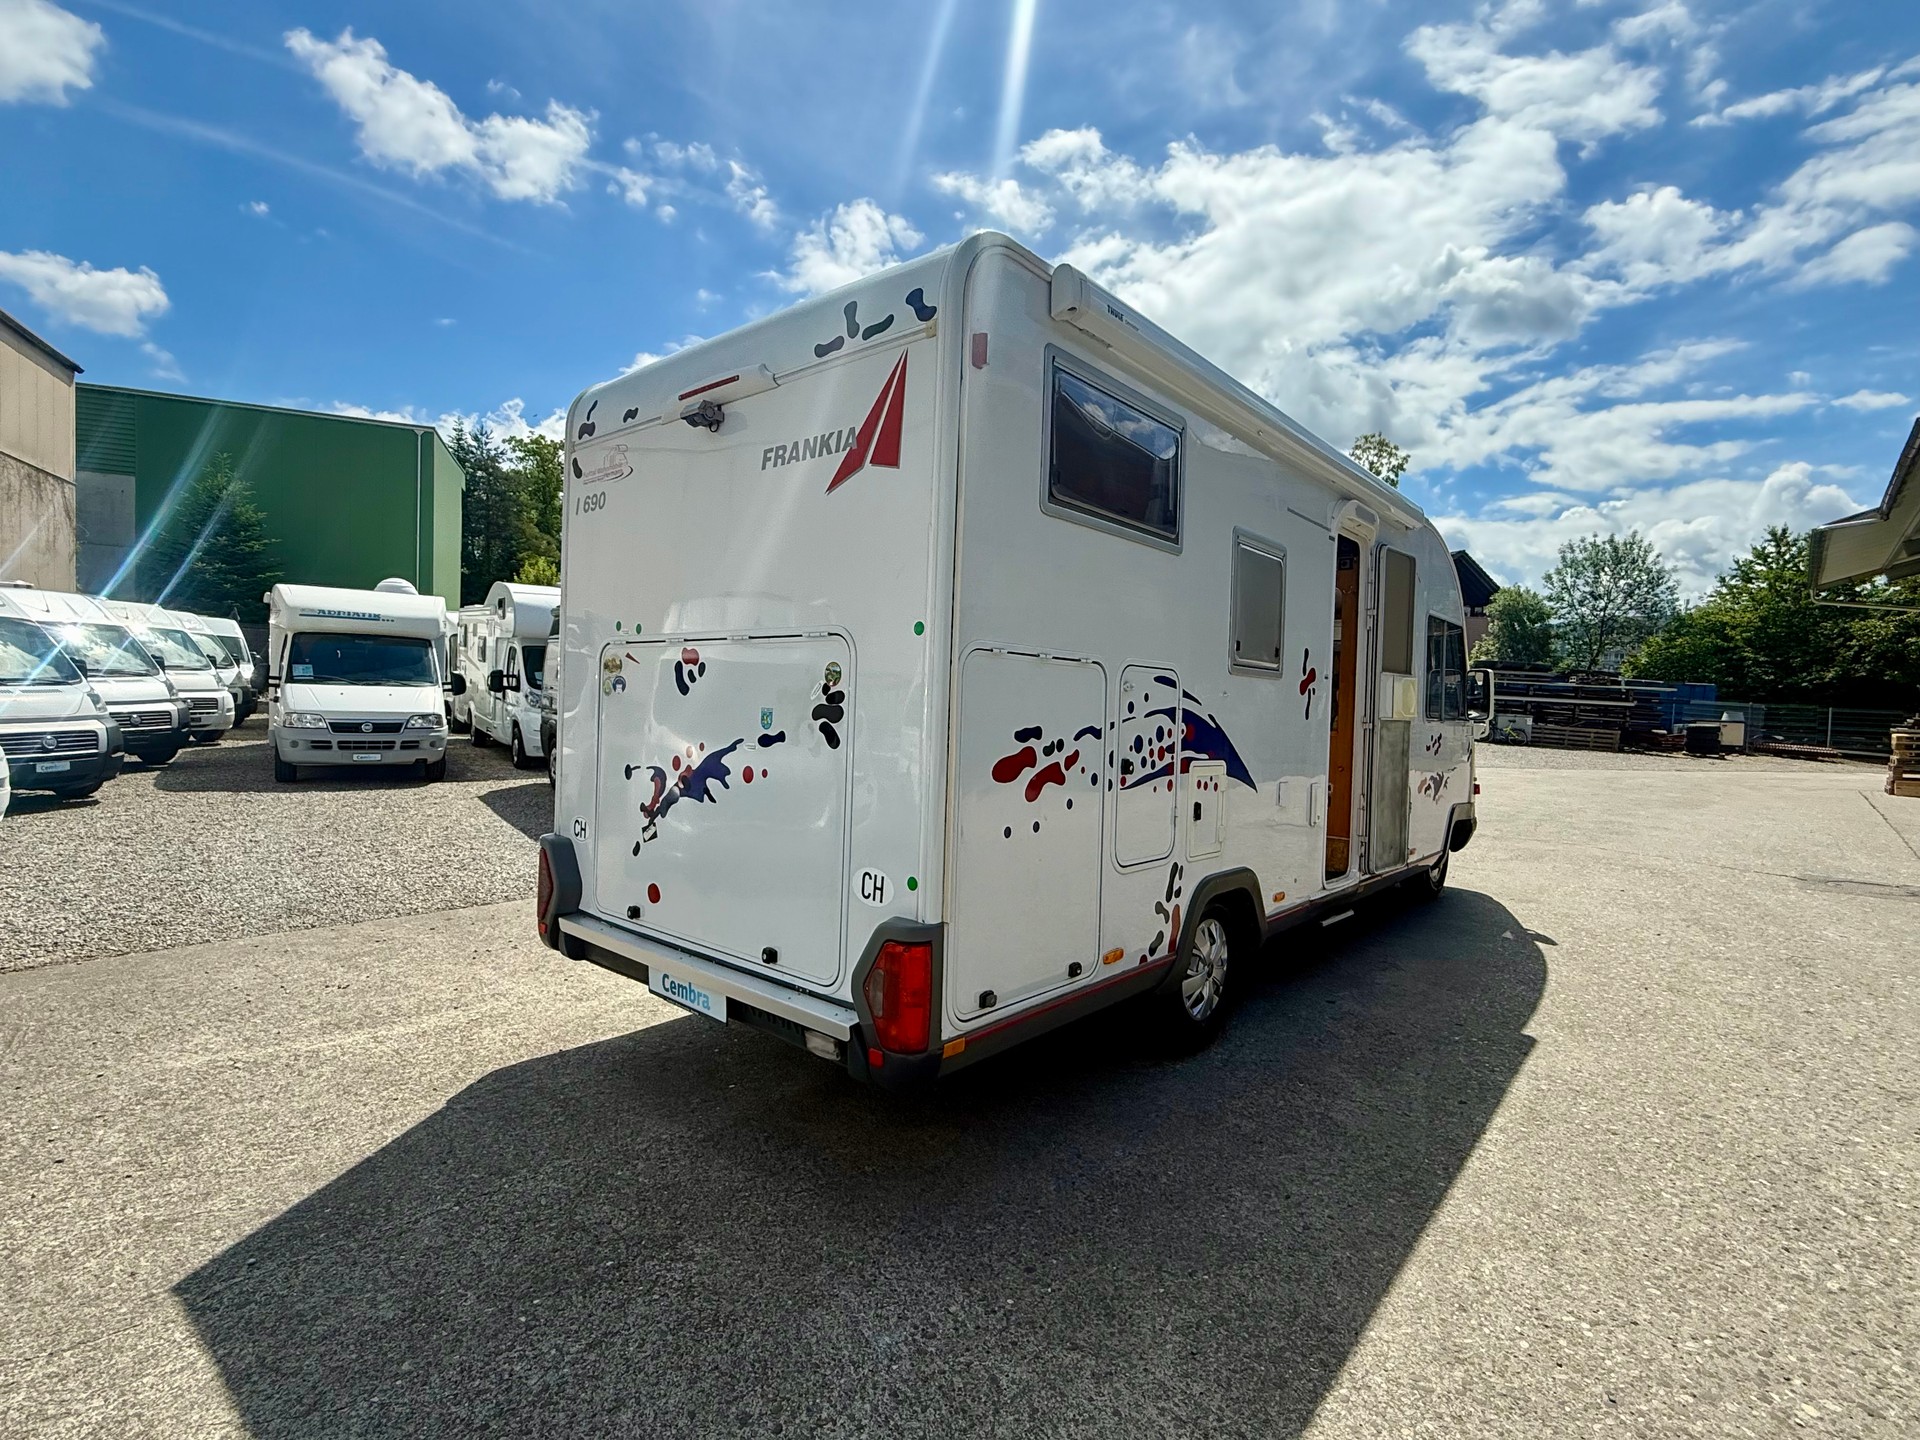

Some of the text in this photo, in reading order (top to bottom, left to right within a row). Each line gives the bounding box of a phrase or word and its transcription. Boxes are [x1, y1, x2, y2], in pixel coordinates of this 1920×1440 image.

[761, 426, 858, 471] FRANKIA
[583, 491, 606, 513] 690
[573, 819, 587, 839] CH
[861, 871, 885, 903] CH
[661, 973, 711, 1011] Cembra
